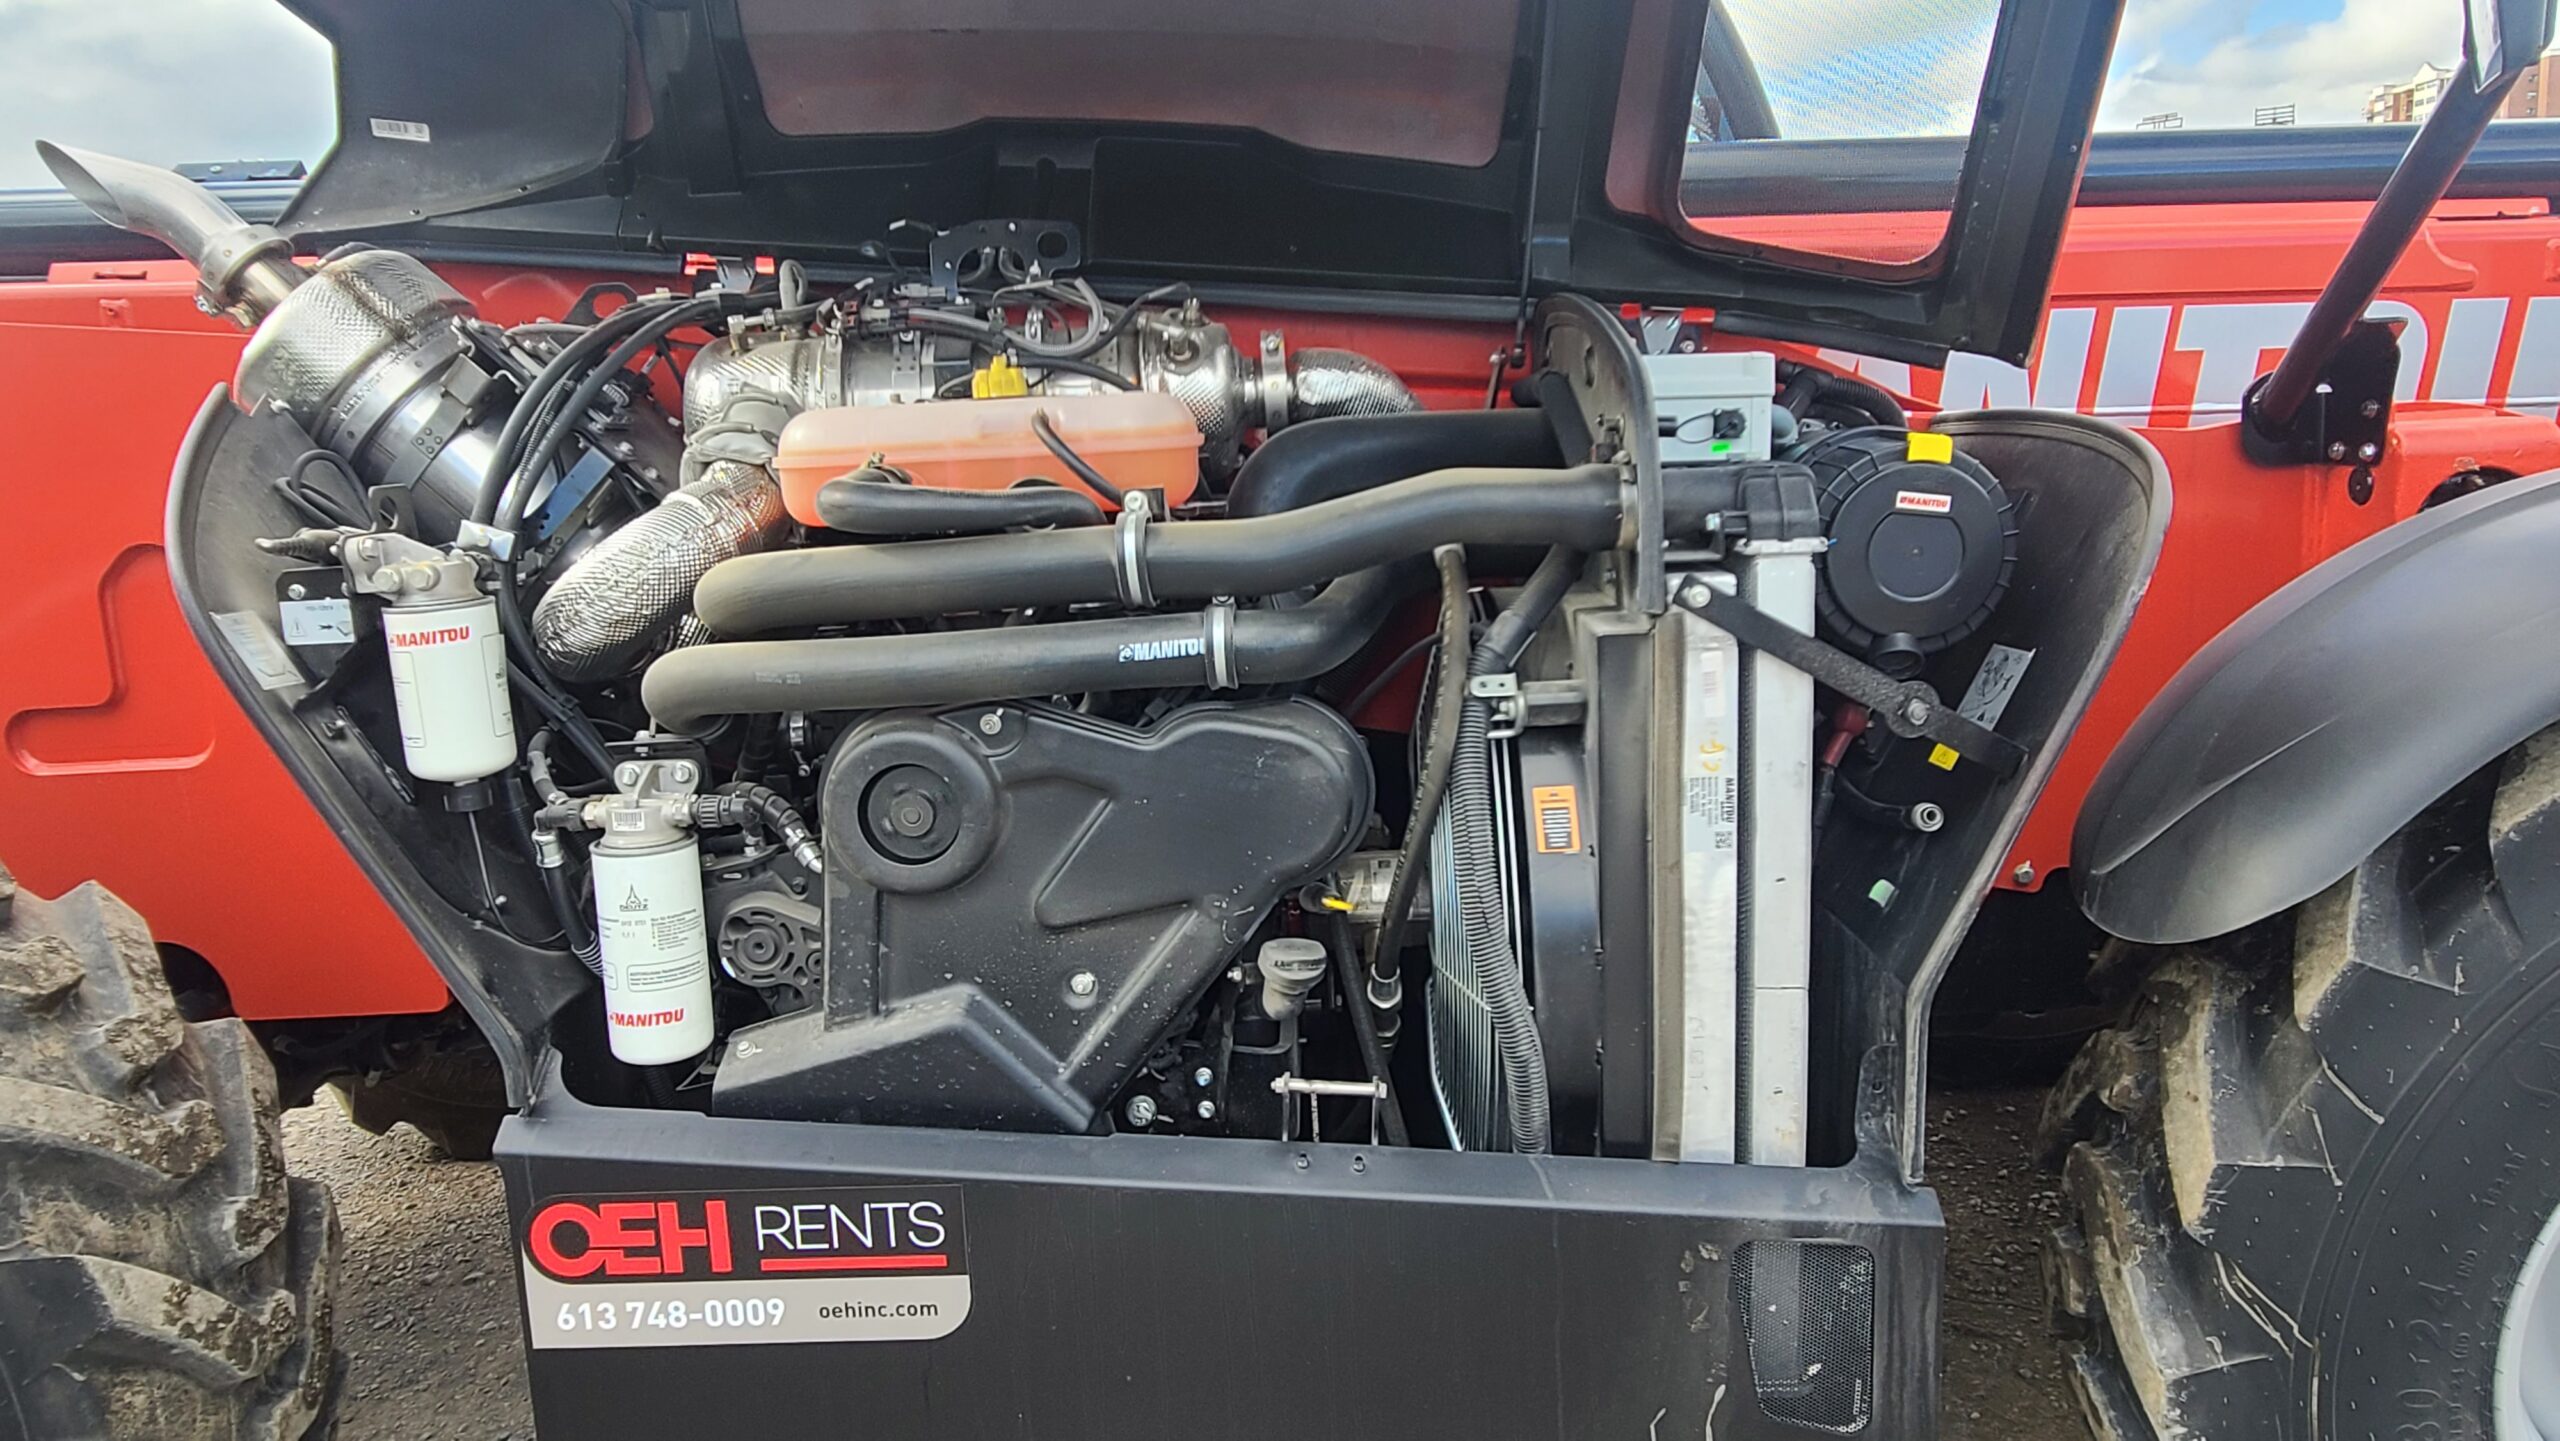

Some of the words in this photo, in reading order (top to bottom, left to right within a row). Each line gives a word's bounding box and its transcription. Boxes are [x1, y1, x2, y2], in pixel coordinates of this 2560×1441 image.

[1907, 496, 1948, 508] MANITOU
[396, 625, 471, 648] MANITOU
[1725, 777, 1735, 824] MANITOU
[614, 1008, 685, 1027] MANITOU
[529, 1199, 733, 1278] OEH
[754, 1200, 946, 1252] RENTS
[556, 1301, 618, 1331] 613
[625, 1297, 786, 1330] 748-0009
[818, 1299, 939, 1319] oehinc.com
